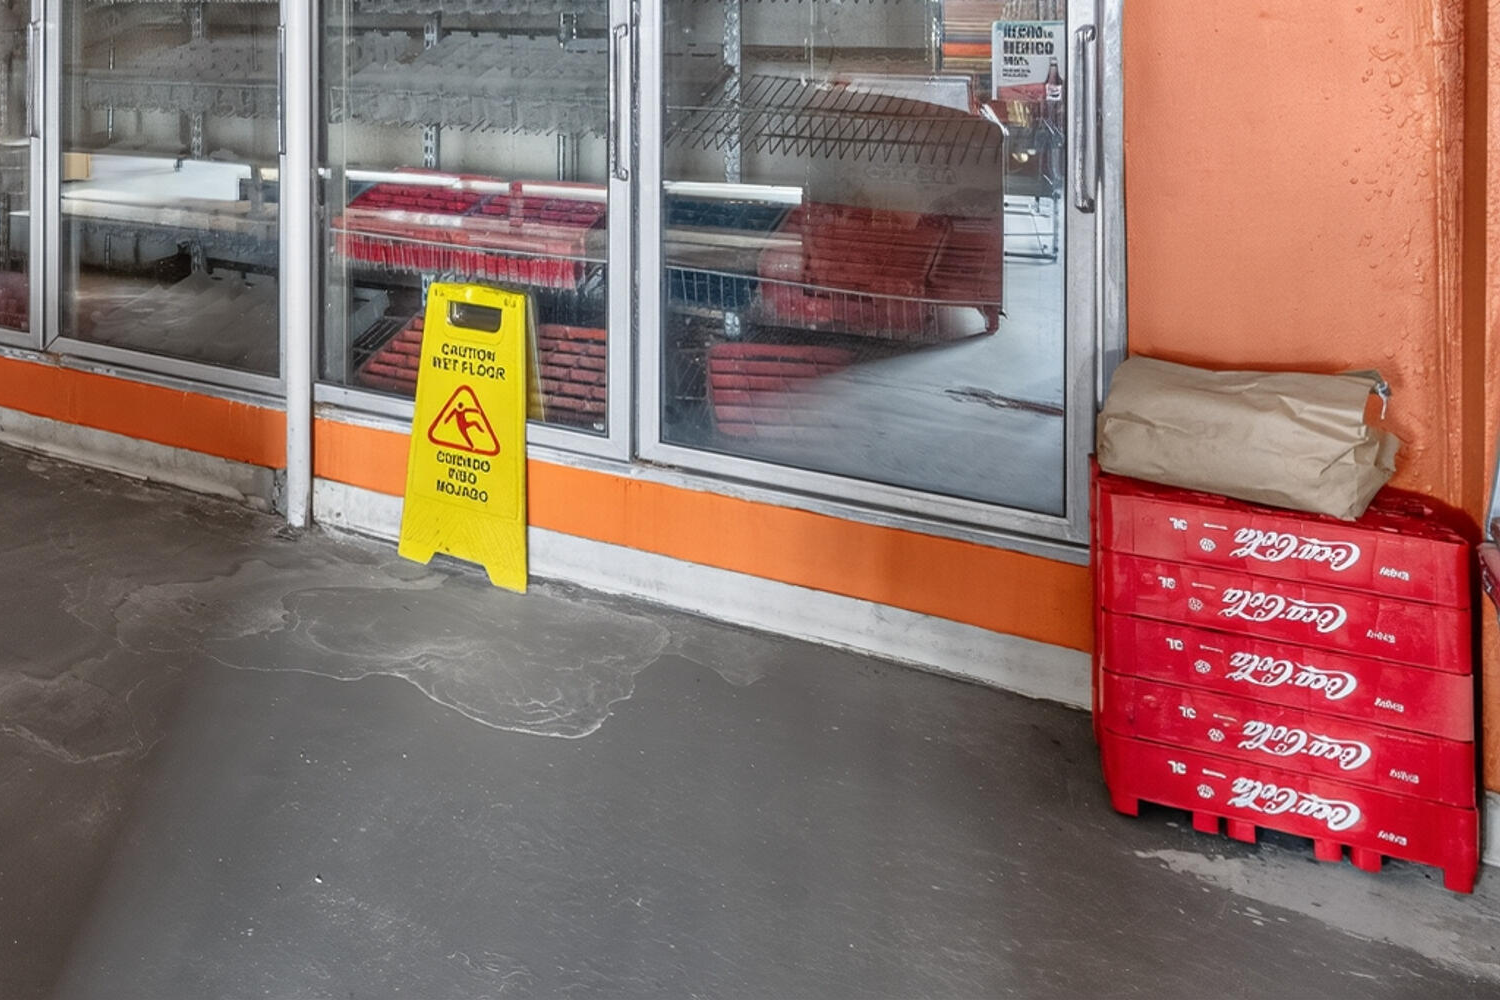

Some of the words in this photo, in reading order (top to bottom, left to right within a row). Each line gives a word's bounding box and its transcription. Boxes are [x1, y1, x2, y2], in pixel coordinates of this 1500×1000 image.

[441, 343, 496, 362] CAUTION
[432, 356, 459, 372] WET
[461, 361, 506, 380] FLOOR
